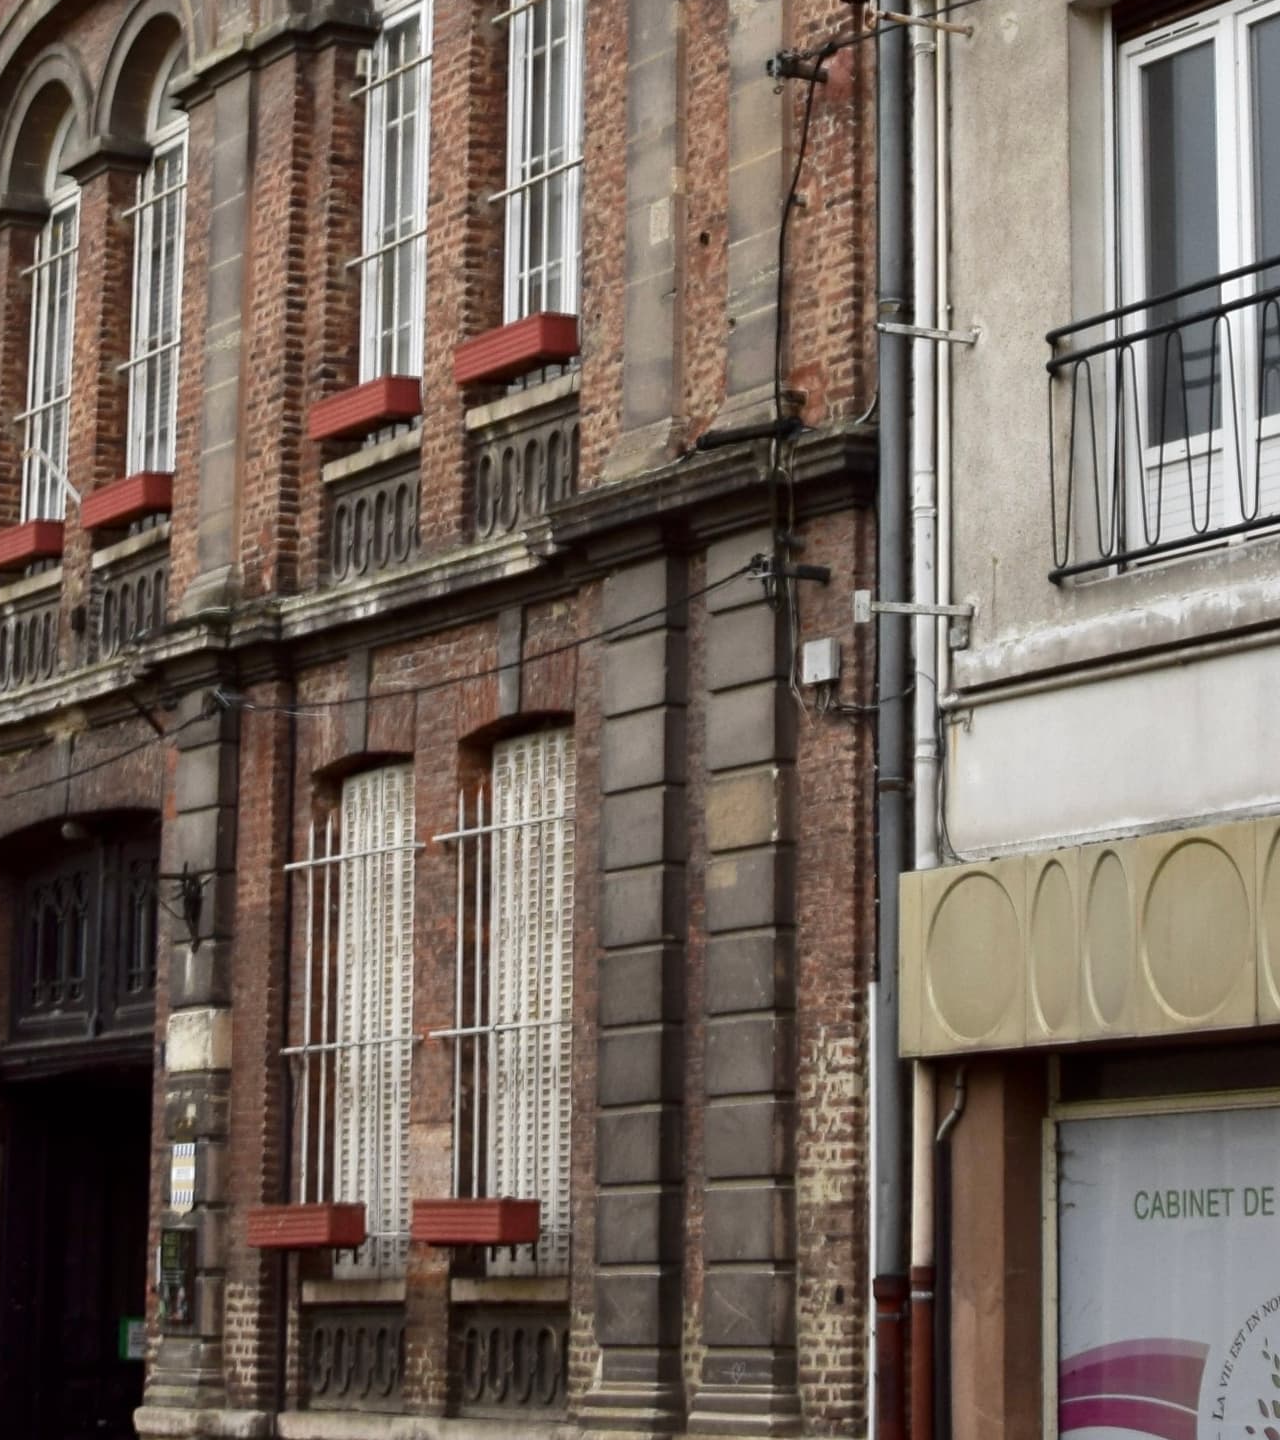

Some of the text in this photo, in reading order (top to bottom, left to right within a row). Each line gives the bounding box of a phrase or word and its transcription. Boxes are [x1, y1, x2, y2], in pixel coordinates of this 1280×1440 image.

[1133, 1187, 1235, 1220] CABINET
[1243, 1185, 1275, 1217] DE
[1219, 1359, 1234, 1389] VIE
[1229, 1329, 1246, 1359] EST
[1245, 1311, 1261, 1333] EN
